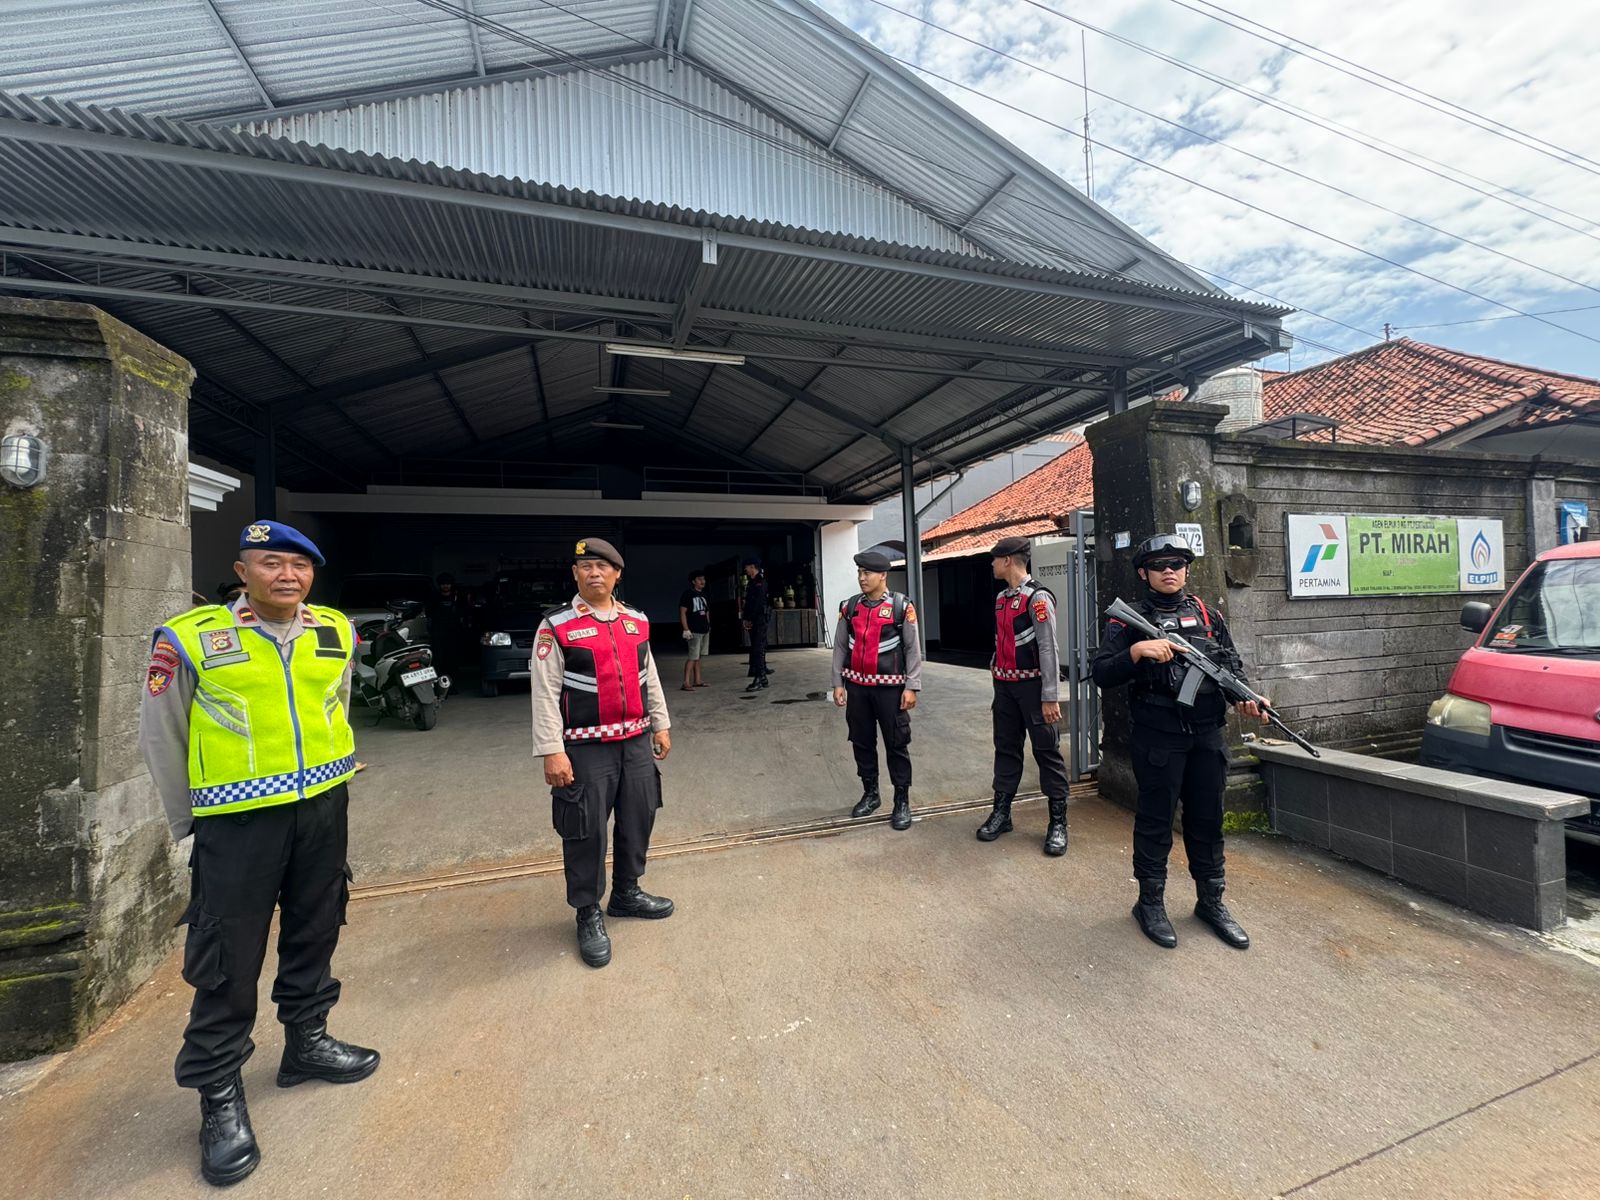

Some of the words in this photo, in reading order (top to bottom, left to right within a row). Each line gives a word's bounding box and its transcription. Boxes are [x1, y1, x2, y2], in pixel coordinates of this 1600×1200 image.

[1359, 532, 1385, 554] PT.
[1391, 533, 1450, 554] MIRAH
[1299, 578, 1341, 588] PERTAMINA
[1469, 573, 1497, 585] ELPIJI
